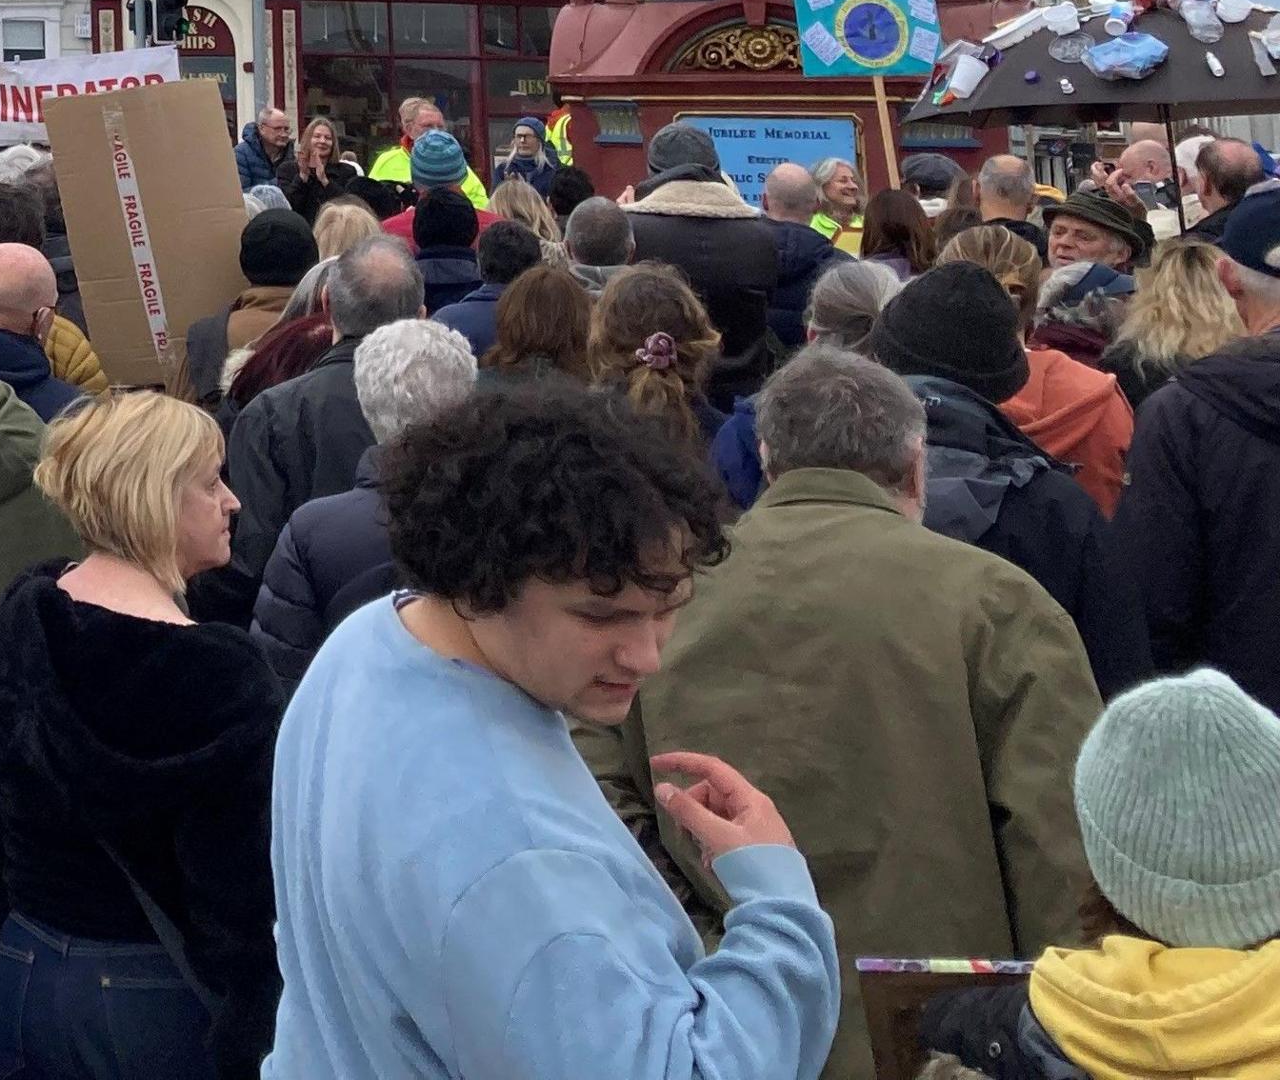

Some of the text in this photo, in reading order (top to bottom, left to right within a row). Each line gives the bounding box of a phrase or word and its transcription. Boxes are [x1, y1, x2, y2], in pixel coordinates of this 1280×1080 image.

[182, 35, 216, 49] HIPS
[188, 22, 198, 34] &
[708, 127, 831, 140] JUBILEE MEMORIAL
[113, 132, 131, 179] AGILE
[123, 194, 146, 248] FRAGILE
[138, 263, 161, 315] FRAGILE
